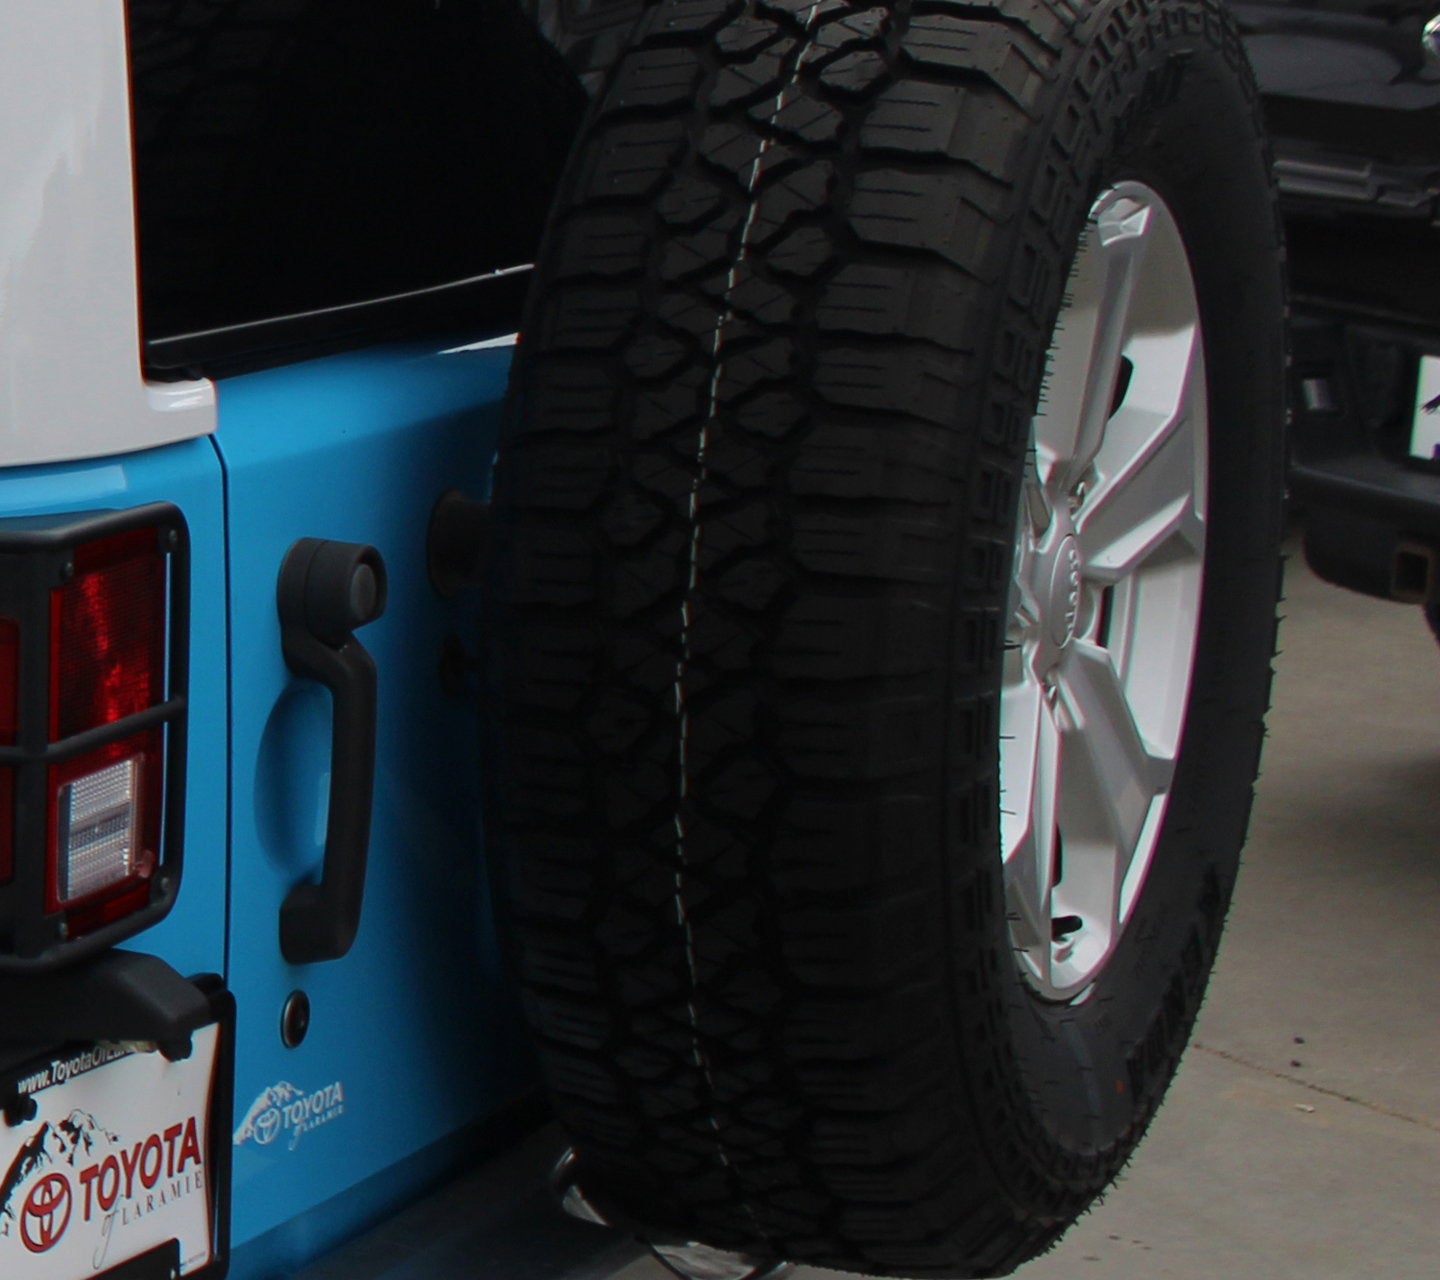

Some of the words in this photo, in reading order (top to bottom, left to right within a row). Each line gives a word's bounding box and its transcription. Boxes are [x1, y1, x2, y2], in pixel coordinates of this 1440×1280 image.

[282, 1081, 343, 1129] TOYOTA
[80, 1116, 202, 1221] TOYOTA
[122, 1171, 203, 1225] LARAMIE
